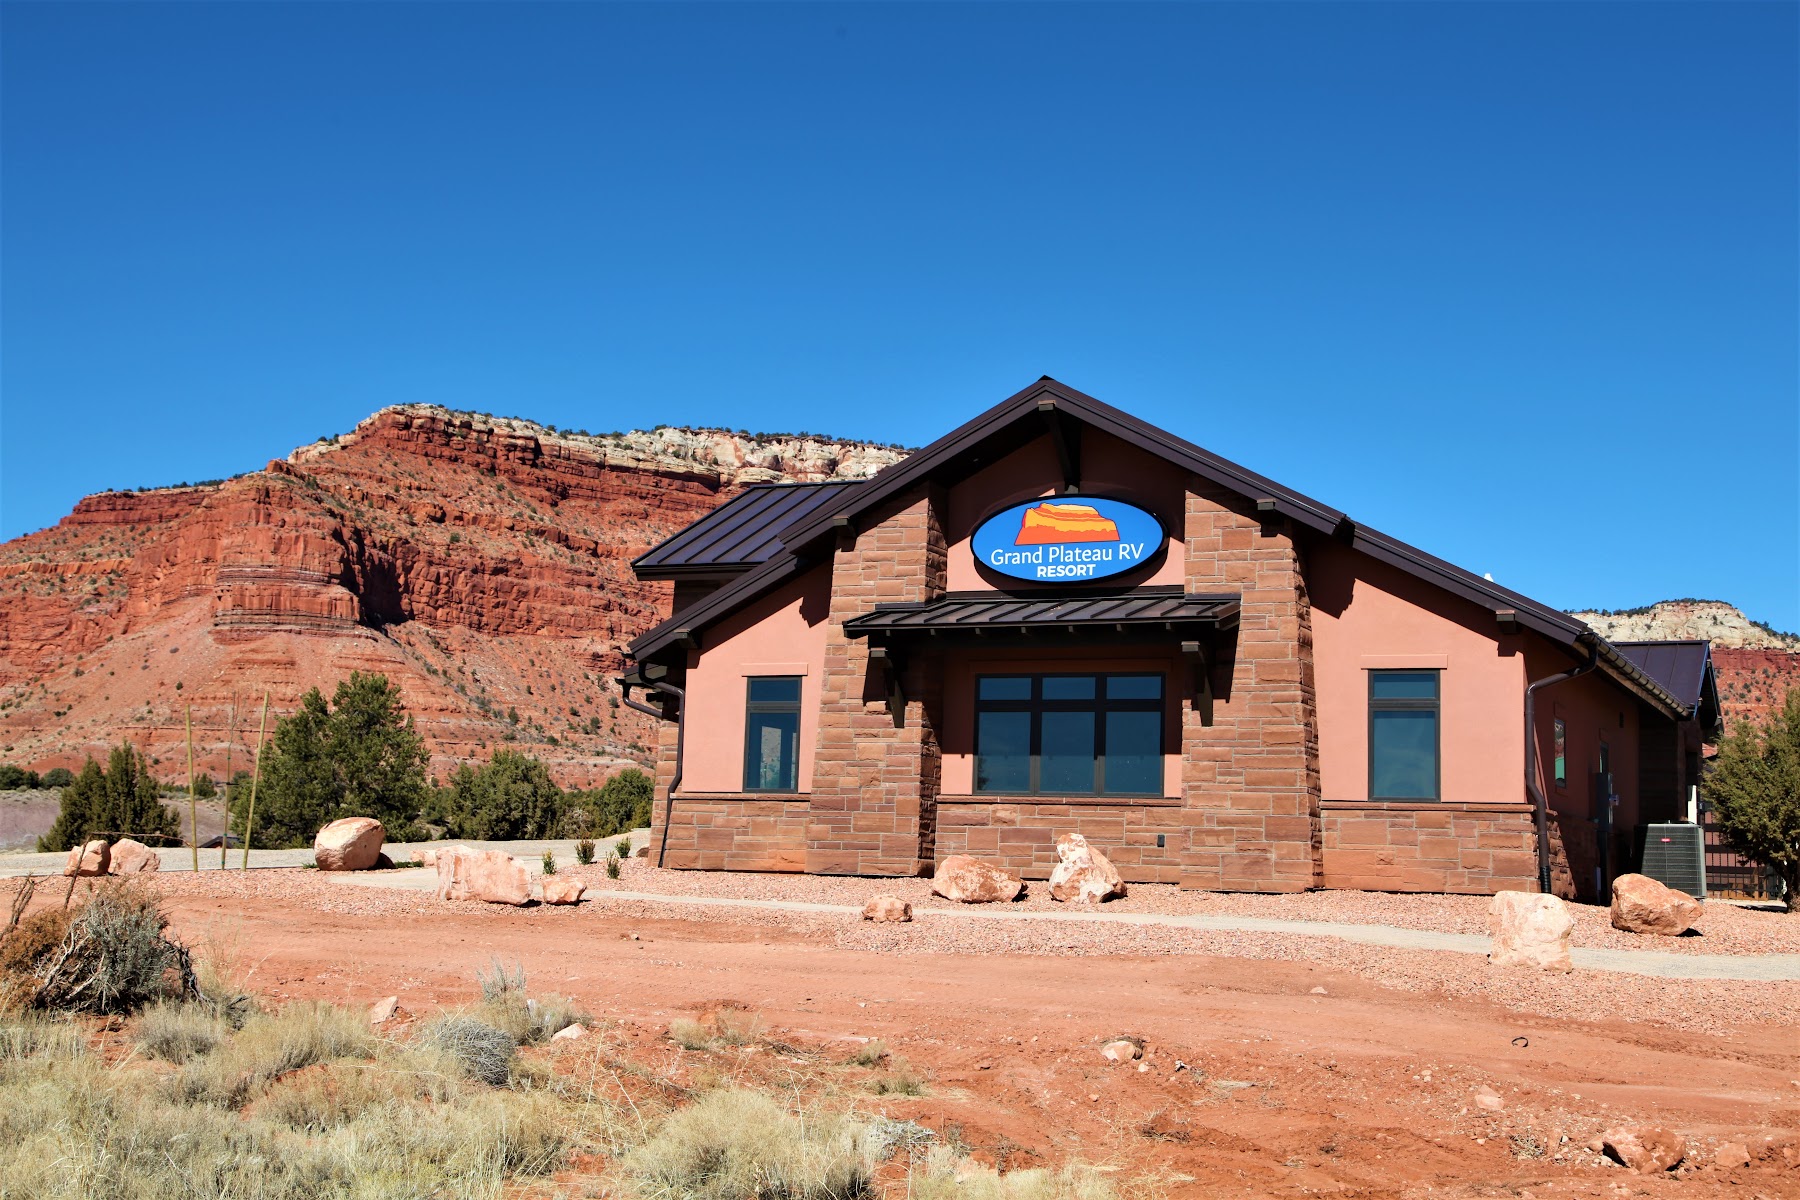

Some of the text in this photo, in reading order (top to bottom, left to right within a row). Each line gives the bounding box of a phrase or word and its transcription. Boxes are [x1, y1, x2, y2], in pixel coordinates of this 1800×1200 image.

[991, 543, 1144, 565] Grand Plateau RV
[1037, 564, 1096, 577] RESORT
